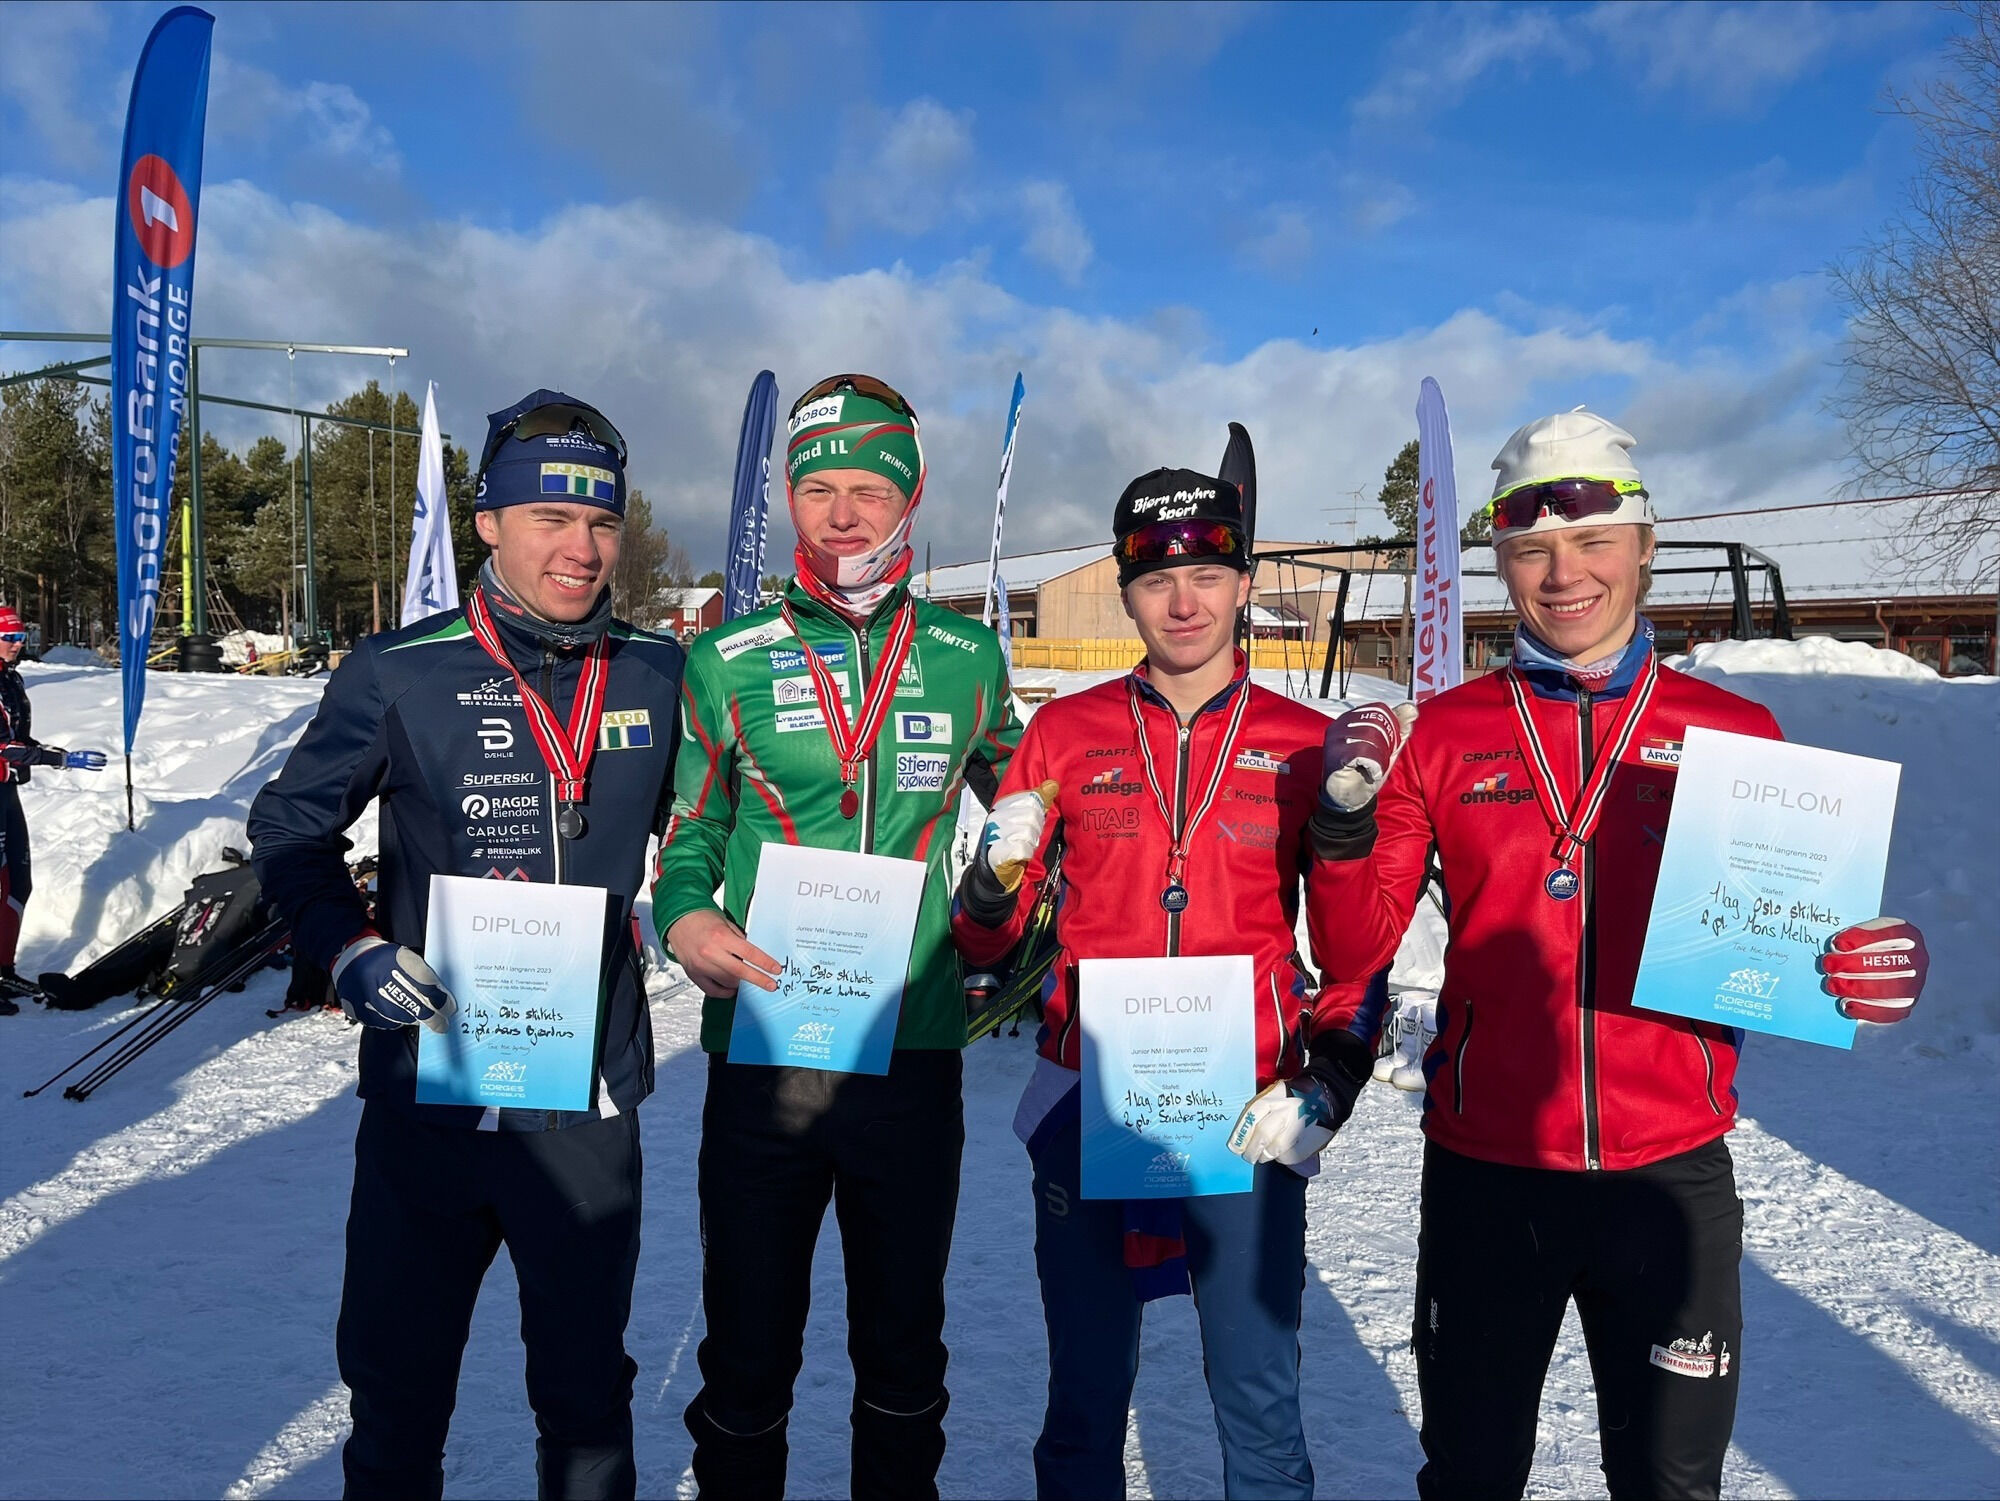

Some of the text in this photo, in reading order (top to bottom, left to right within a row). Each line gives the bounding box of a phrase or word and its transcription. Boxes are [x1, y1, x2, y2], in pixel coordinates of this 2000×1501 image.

[802, 405, 838, 423] OBOS
[830, 439, 849, 455] IL
[879, 450, 913, 480] TRIMTEX
[1132, 487, 1216, 513] Bjørn Myhre
[1157, 503, 1198, 521] Sport
[720, 634, 765, 655] SKULLERUD
[754, 636, 776, 647] PARK
[927, 625, 979, 654] TRIMTEX
[912, 722, 946, 733] Medical
[1085, 748, 1129, 759] CRAFT
[1462, 750, 1514, 762] CRAFT
[1646, 749, 1682, 762] ÅRVO
[897, 754, 948, 775] Stjerne
[1235, 757, 1268, 768] RVOLL
[463, 772, 534, 786] SUPERSKI
[1081, 781, 1143, 797] omega
[1460, 788, 1535, 805] omega
[491, 795, 540, 809] RAGDE
[1731, 779, 1842, 817] DIPLOM
[492, 806, 540, 819] Eiendom
[1081, 807, 1140, 832] ITAB
[466, 823, 541, 837] CARUCEL
[487, 847, 542, 856] BREIDABLIKK
[1730, 838, 1753, 849] Junior
[1754, 842, 1769, 852] NM
[1808, 851, 1828, 863] 2023
[797, 880, 881, 905] DIPLOM
[1760, 886, 1784, 897] Stafett
[1753, 896, 1781, 921] Oslo
[472, 915, 561, 937] DIPLOM
[1862, 954, 1912, 967] HESTRA
[384, 980, 421, 1017] HESTRA
[1125, 995, 1212, 1015] DIPLOM
[1714, 994, 1773, 1013] NORGES
[480, 1083, 525, 1092] NORGES
[1157, 1092, 1181, 1108] Oslo
